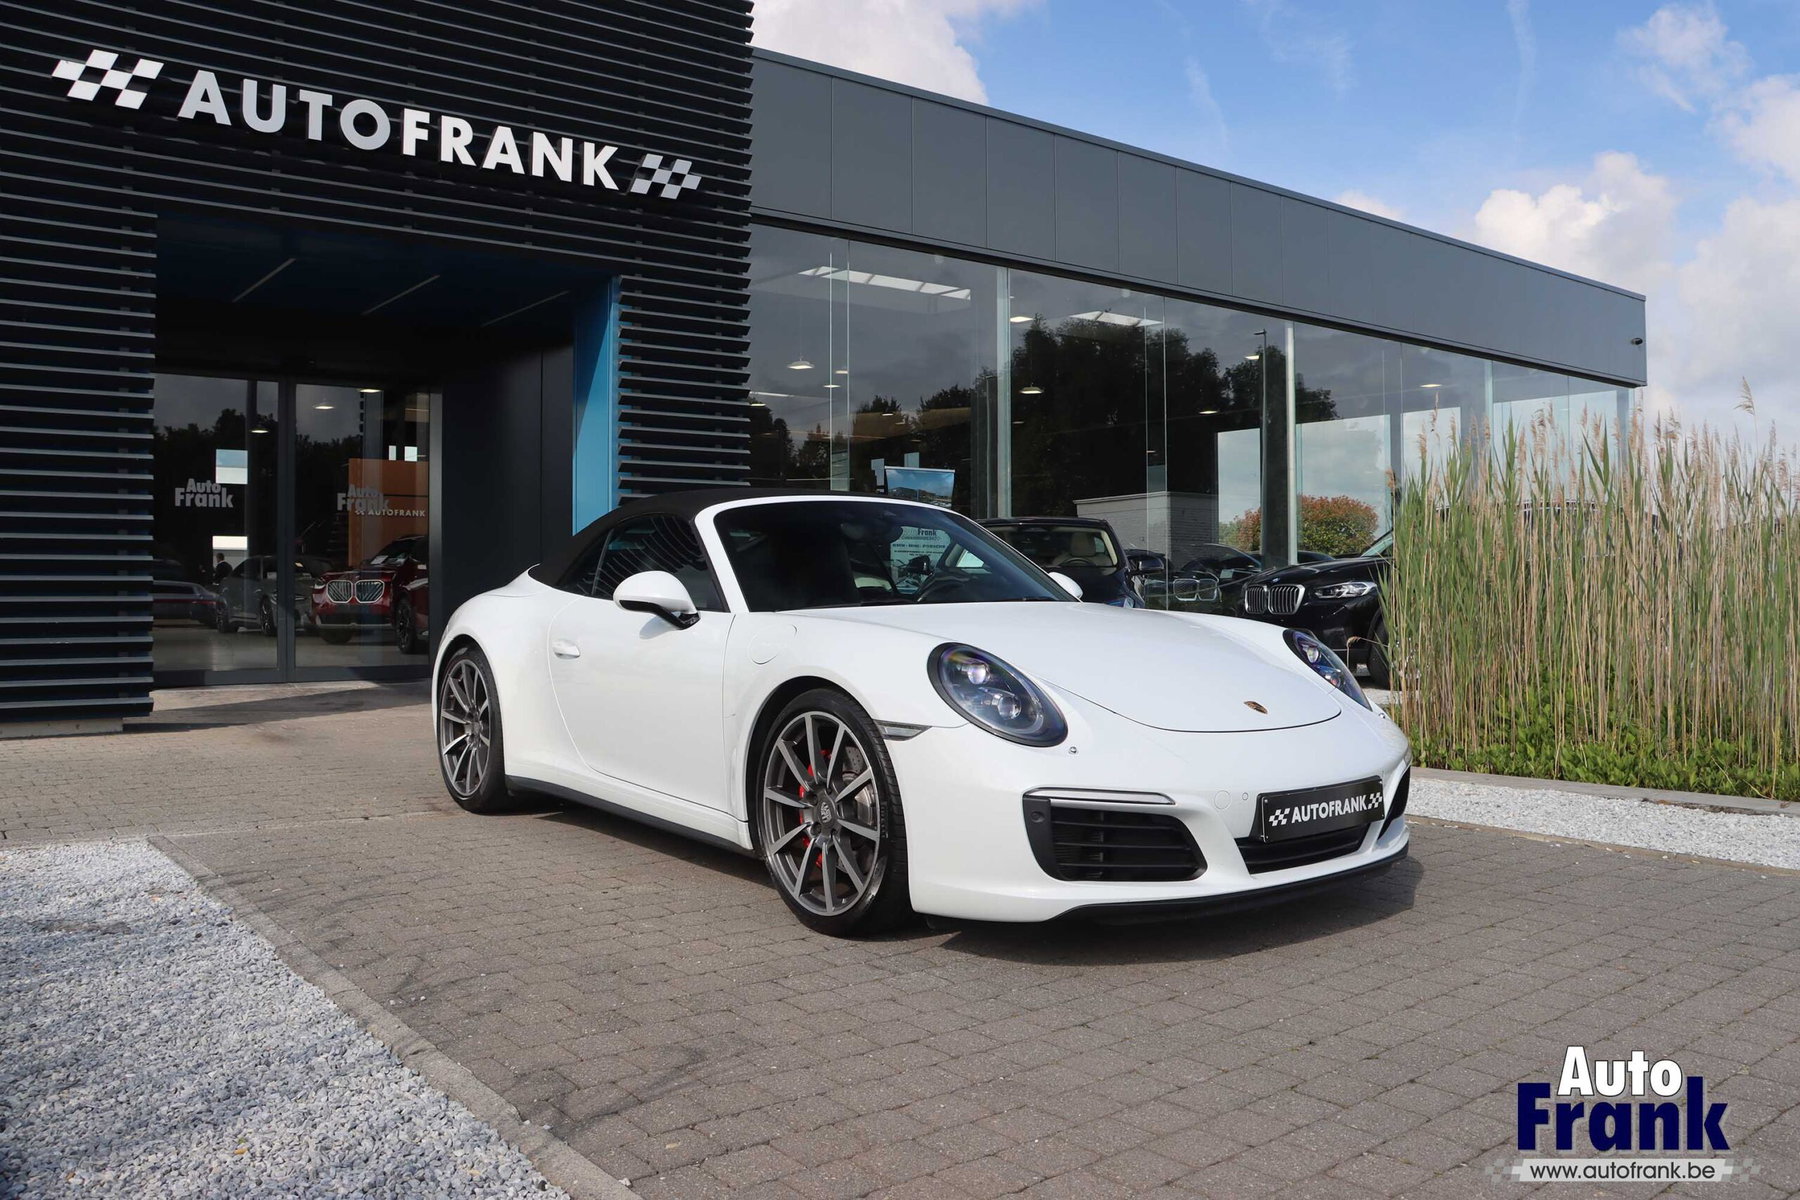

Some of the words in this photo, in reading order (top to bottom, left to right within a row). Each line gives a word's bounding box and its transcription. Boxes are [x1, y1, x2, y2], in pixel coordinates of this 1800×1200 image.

[177, 70, 620, 191] AUTOFRANK
[186, 478, 221, 493] Auto
[347, 484, 378, 498] Auto
[175, 487, 234, 507] Frank
[337, 492, 389, 511] Frank
[368, 509, 425, 517] AUTOFRANK
[1291, 795, 1367, 823] AUTOFRANK
